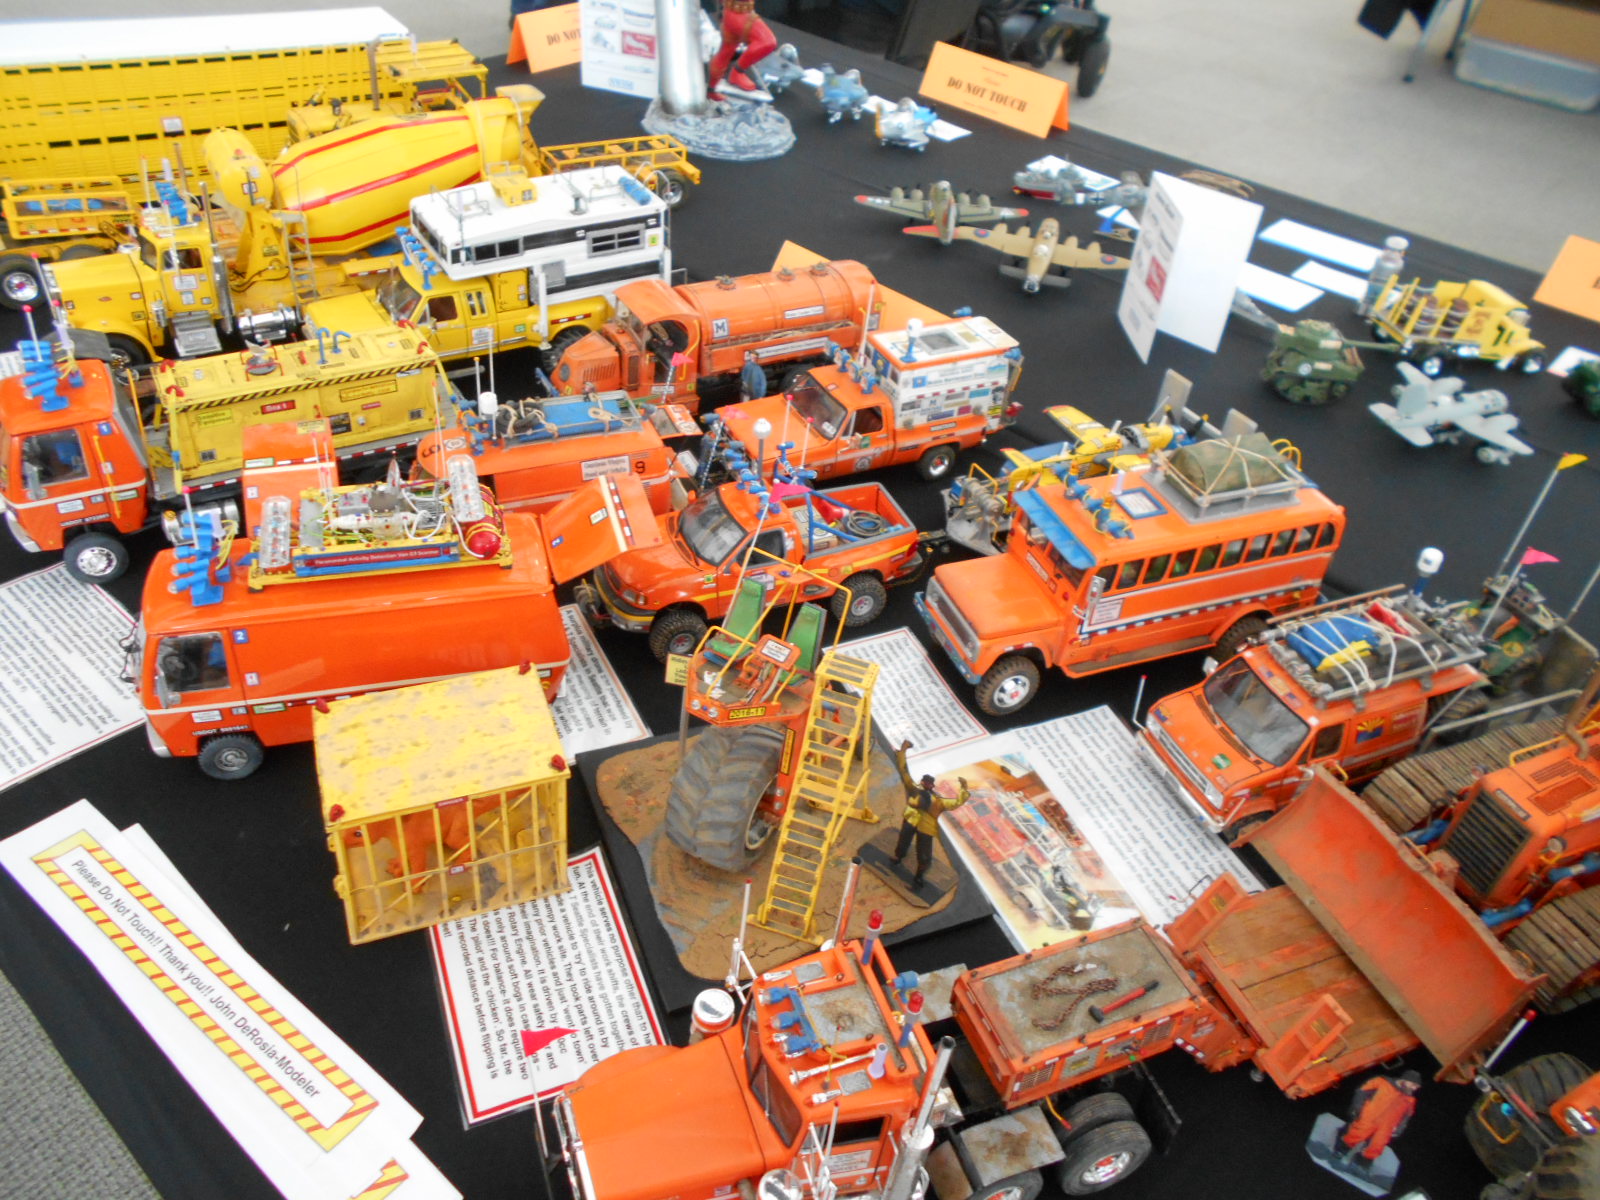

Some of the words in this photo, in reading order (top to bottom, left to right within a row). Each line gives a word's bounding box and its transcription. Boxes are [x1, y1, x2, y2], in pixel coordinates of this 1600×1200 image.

[546, 32, 561, 46] DO
[562, 28, 582, 42] NOT
[946, 76, 962, 90] DO
[966, 82, 986, 98] NOT
[989, 90, 1029, 113] TOUCH
[236, 631, 245, 641] 2
[571, 864, 581, 880] fun.
[584, 860, 594, 879] This
[577, 881, 585, 890] At
[589, 878, 603, 906] vehicle
[580, 889, 589, 903] the
[570, 901, 584, 927] Seattle
[584, 903, 596, 918] end
[598, 906, 612, 932] serves
[468, 917, 477, 932] The
[494, 916, 505, 934] only
[507, 910, 519, 936] Rotary
[533, 917, 546, 936] prior
[561, 913, 575, 941] vehicle
[589, 918, 599, 928] of
[523, 920, 541, 966] imagination.
[551, 923, 562, 944] work
[592, 927, 604, 946] their
[608, 932, 617, 944] no
[489, 946, 498, 961] For
[499, 934, 513, 963] around
[514, 936, 527, 965] Engine.
[541, 937, 556, 970] vehicles
[570, 940, 578, 951] to
[579, 927, 598, 970] Specialists
[477, 955, 488, 972] and
[599, 946, 612, 967] work
[610, 944, 628, 977] purpose
[72, 860, 102, 889] Please
[98, 884, 115, 901] Do
[110, 895, 132, 917] Not
[131, 912, 163, 948] Touch!!
[158, 944, 188, 974] Thank
[186, 970, 215, 997] you!!
[210, 996, 238, 1023] John
[233, 1016, 321, 1100] DeRosia-Modeler
[481, 971, 490, 986] the
[507, 963, 518, 980] soft
[522, 968, 533, 980] All
[538, 975, 547, 985] is
[551, 970, 563, 987] and
[563, 961, 574, 982] They
[578, 966, 586, 976] to
[593, 970, 605, 991] have
[511, 980, 523, 1002] bogs
[526, 980, 537, 1001] wear
[554, 986, 568, 1004] just
[569, 982, 581, 1002] took
[582, 977, 592, 994] ride
[623, 978, 636, 1000] other
[457, 930, 472, 967] recorded
[465, 967, 480, 1003] distance
[474, 1002, 487, 1032] before
[481, 1032, 495, 1069] flipping
[489, 1068, 498, 1079] is
[518, 1002, 526, 1013] in
[541, 984, 554, 1012] driven
[598, 991, 614, 1020] gotten
[615, 993, 625, 1008] the
[503, 1005, 515, 1028] does
[532, 1002, 545, 1028] safety
[548, 1011, 558, 1024] by
[573, 1002, 587, 1026] parts
[587, 995, 603, 1026] around
[631, 1000, 643, 1021] than
[597, 1025, 605, 1036] in
[620, 1009, 634, 1036] crews
[639, 1020, 647, 1032] to
[495, 1028, 505, 1042] So
[583, 1025, 594, 1042] left
[600, 1035, 609, 1048] by
[609, 1020, 626, 1054] togethe
[629, 1036, 640, 1046] of
[510, 1028, 527, 1061] require
[587, 1042, 600, 1062] over
[502, 1058, 512, 1075] the
[545, 1051, 558, 1070] and
[518, 1061, 528, 1080] two
